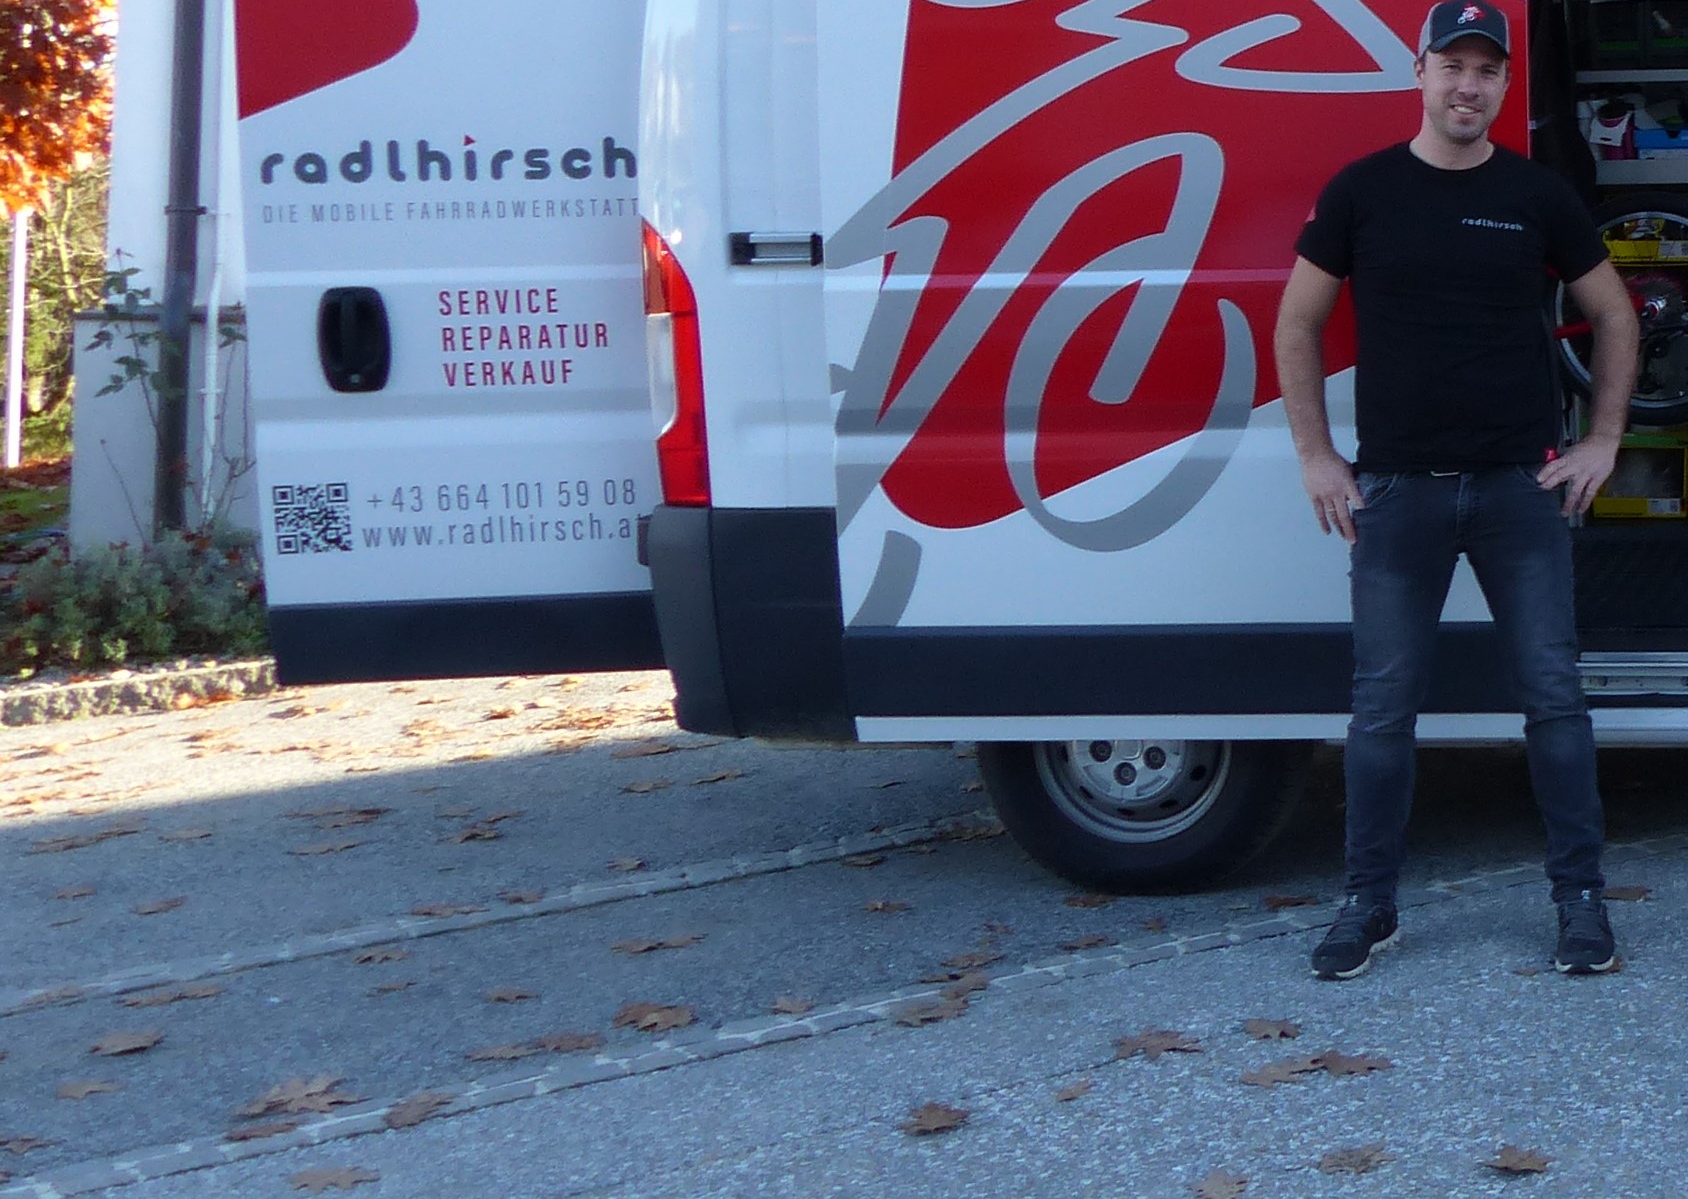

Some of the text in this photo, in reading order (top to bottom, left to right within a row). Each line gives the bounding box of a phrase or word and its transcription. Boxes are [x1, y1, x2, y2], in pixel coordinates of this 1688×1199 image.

[260, 135, 638, 184] radlhirsch
[263, 197, 638, 224] DIE MOBILE FAHRRADWERKSTATT
[439, 288, 559, 316] SERVICE
[443, 323, 609, 352] REPARATUR
[444, 359, 574, 387] VERKAUF
[366, 479, 635, 513] +43 664 101 59 08
